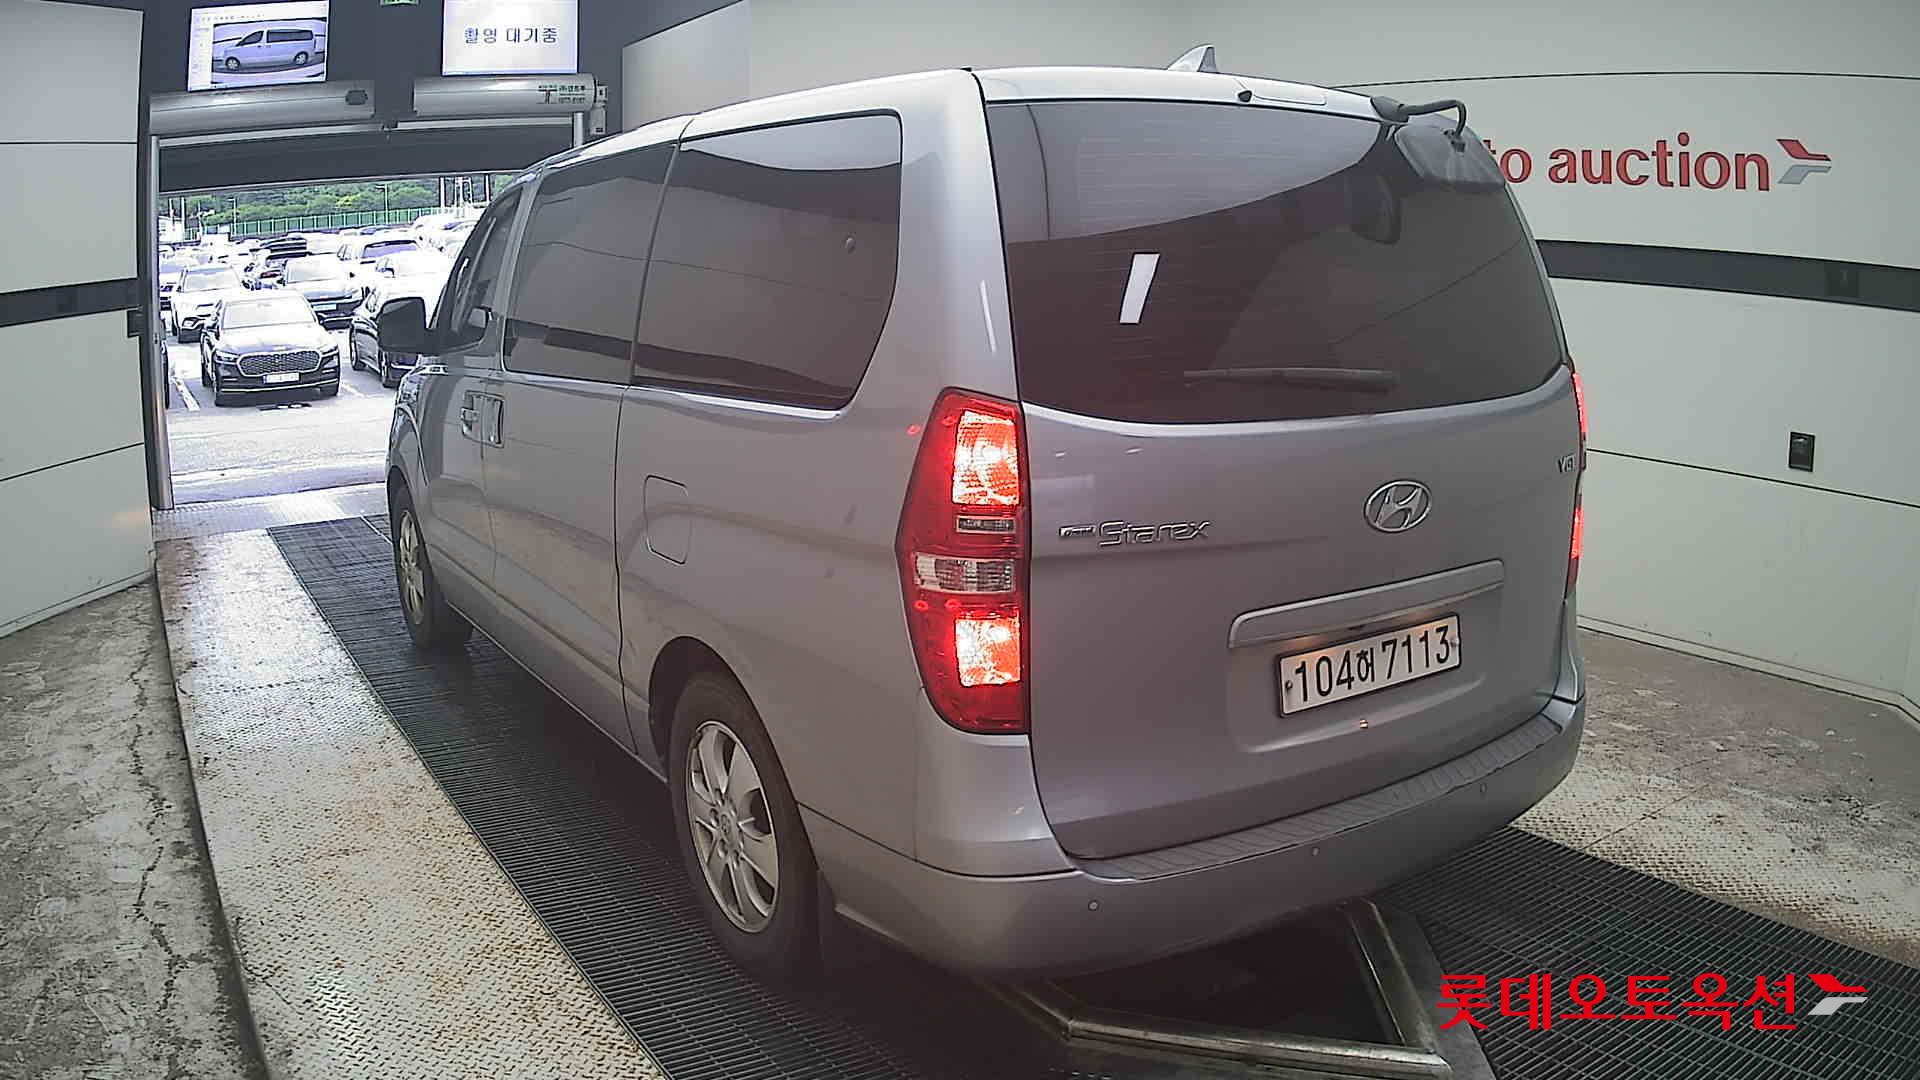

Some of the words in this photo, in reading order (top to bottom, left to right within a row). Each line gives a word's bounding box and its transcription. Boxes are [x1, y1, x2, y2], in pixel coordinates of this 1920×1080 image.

[464, 27, 497, 44] 촬영
[506, 27, 558, 43] 대기중
[1548, 132, 1770, 192] auction
[1099, 520, 1211, 547] Starex
